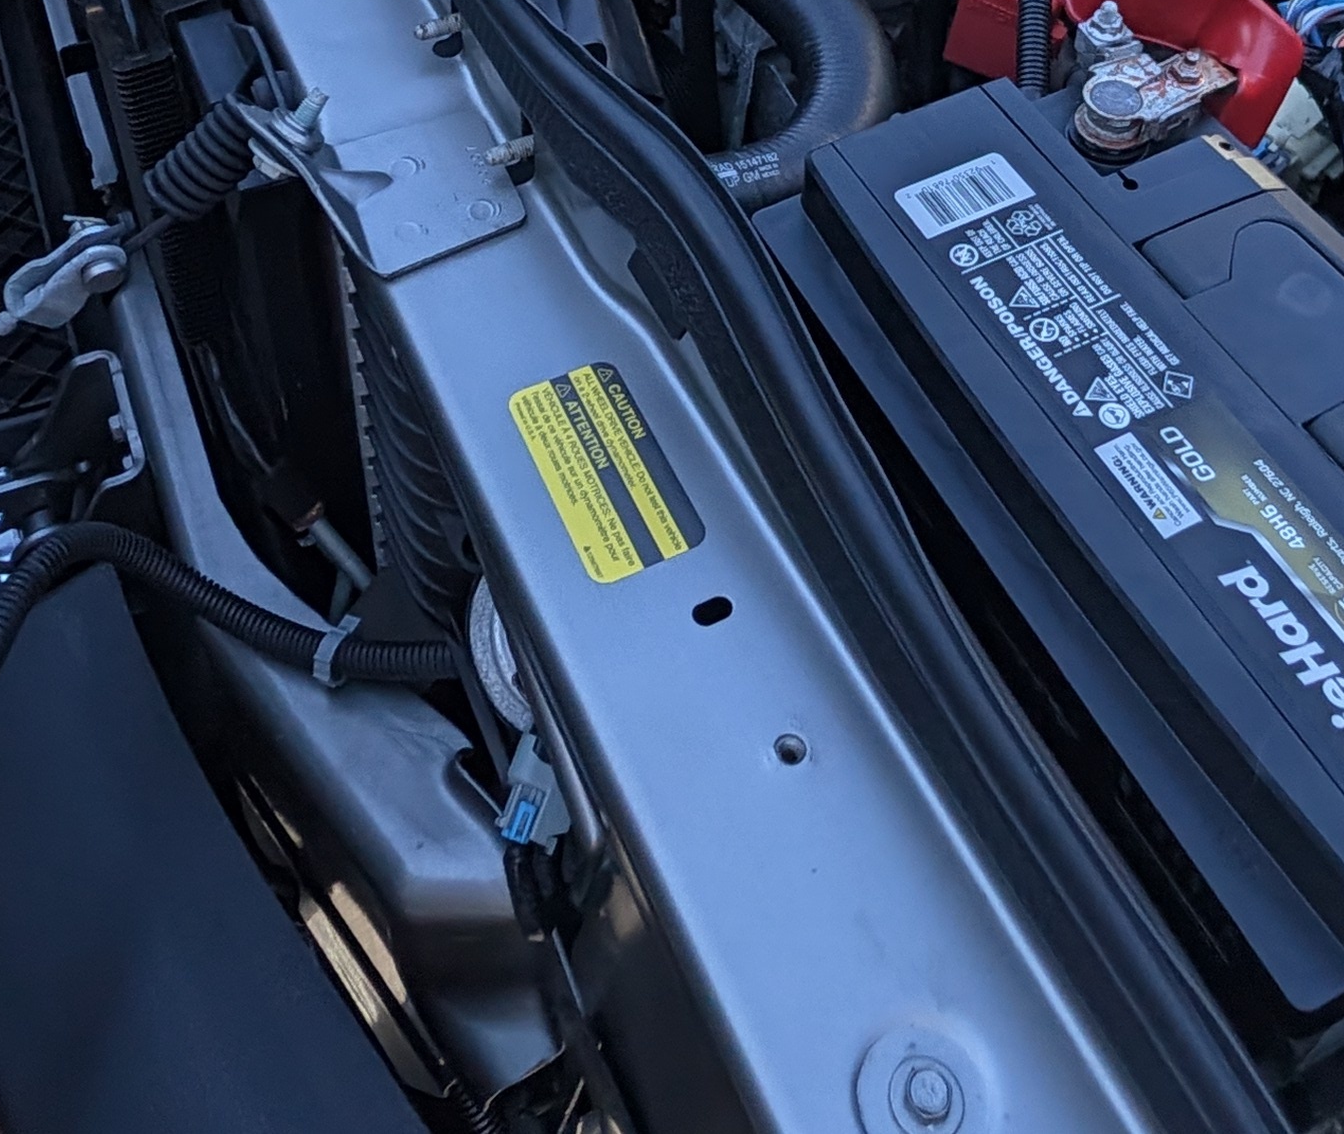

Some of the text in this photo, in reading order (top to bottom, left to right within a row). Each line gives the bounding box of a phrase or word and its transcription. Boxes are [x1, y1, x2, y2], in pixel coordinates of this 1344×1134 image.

[742, 169, 761, 183] GM
[967, 274, 1082, 406] DANGER/POISON
[581, 371, 596, 387] ALL
[1097, 352, 1125, 378] GASES
[572, 375, 582, 386] on
[595, 418, 611, 438] drive
[588, 384, 611, 414] WHEEL
[1116, 374, 1157, 415] EXPLOSIVE
[1117, 391, 1147, 420] SHIELD
[603, 410, 623, 437] DRIVE
[605, 381, 647, 440] CAUTION
[563, 398, 611, 470] ATTENTION
[567, 439, 589, 470] ROUES
[1155, 422, 1218, 484] GOLD
[541, 412, 552, 424] de
[573, 477, 584, 490] un
[603, 542, 620, 563] pour
[634, 470, 648, 483] Do
[1108, 454, 1158, 511] WARNING:
[1251, 457, 1285, 490] 27604
[641, 482, 654, 496] not
[1277, 485, 1296, 502] NC
[605, 517, 619, 531] Ne
[655, 508, 670, 524] this
[1257, 502, 1309, 553] 48H6
[611, 530, 626, 548] pas
[663, 523, 684, 551] vehicle
[620, 546, 637, 567] faire
[1310, 554, 1344, 591] CAPACITY
